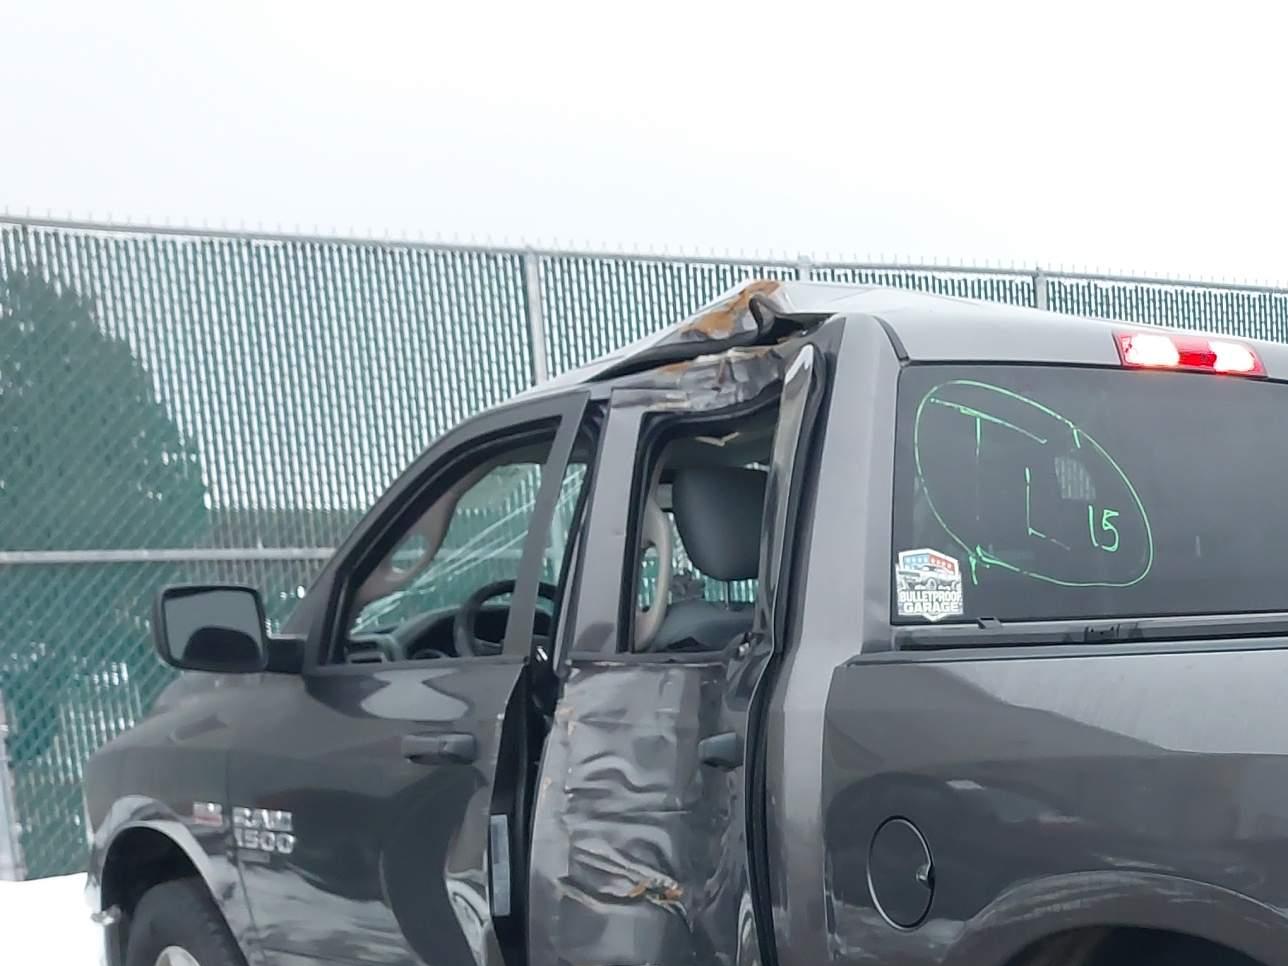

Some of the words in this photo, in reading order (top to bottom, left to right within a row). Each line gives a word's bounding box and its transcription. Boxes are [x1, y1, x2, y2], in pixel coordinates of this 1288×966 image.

[899, 591, 962, 603] BULLETPROOF
[903, 601, 961, 614] GARAGE
[234, 828, 296, 854] 1500
